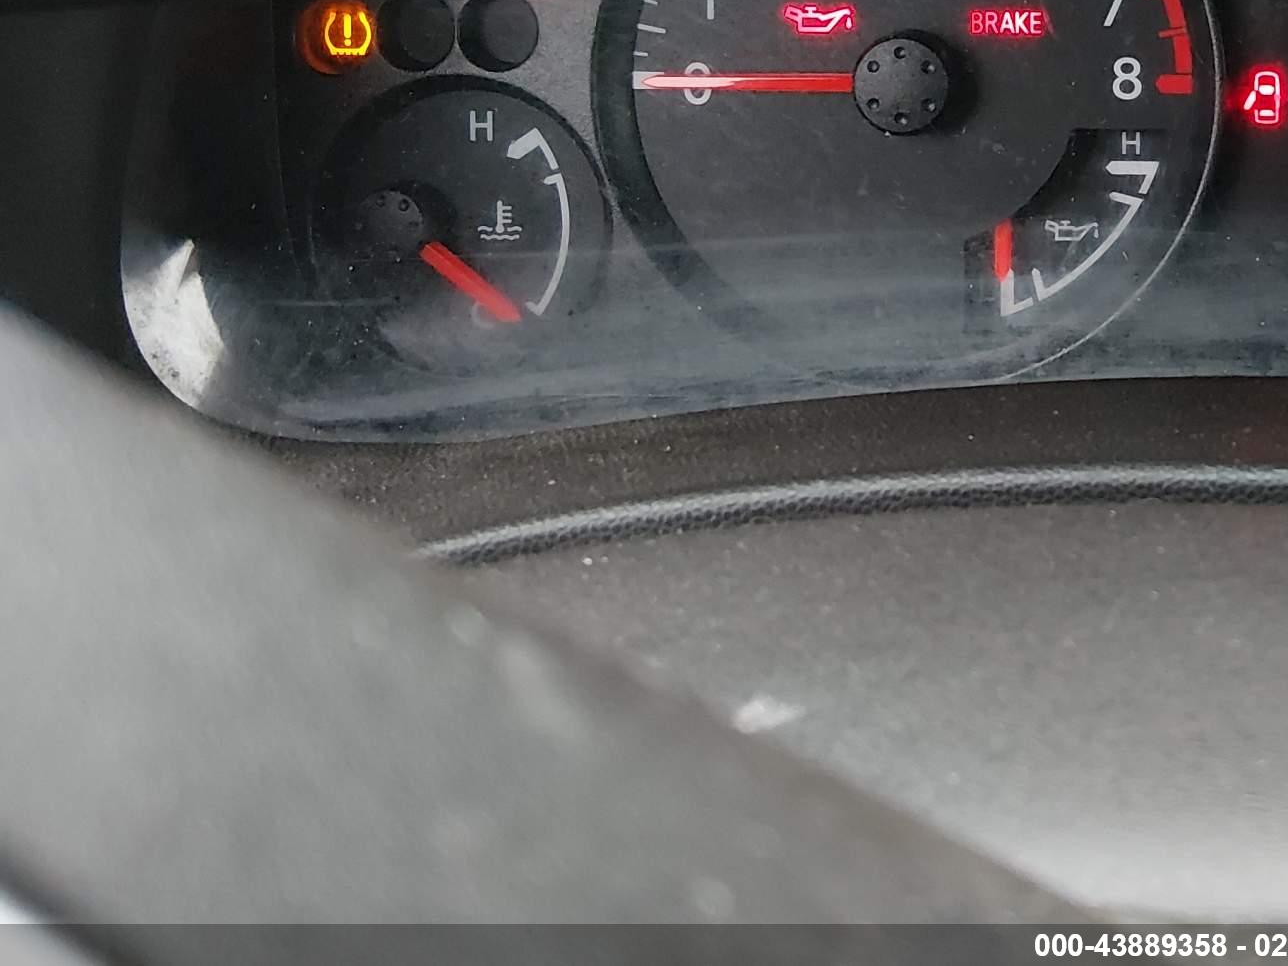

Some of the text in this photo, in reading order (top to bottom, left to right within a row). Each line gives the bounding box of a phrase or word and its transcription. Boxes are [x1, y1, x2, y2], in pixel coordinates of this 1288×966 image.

[971, 11, 1042, 34] BRAKE
[1112, 56, 1142, 101] 8
[469, 110, 494, 142] H
[1121, 132, 1141, 155] H
